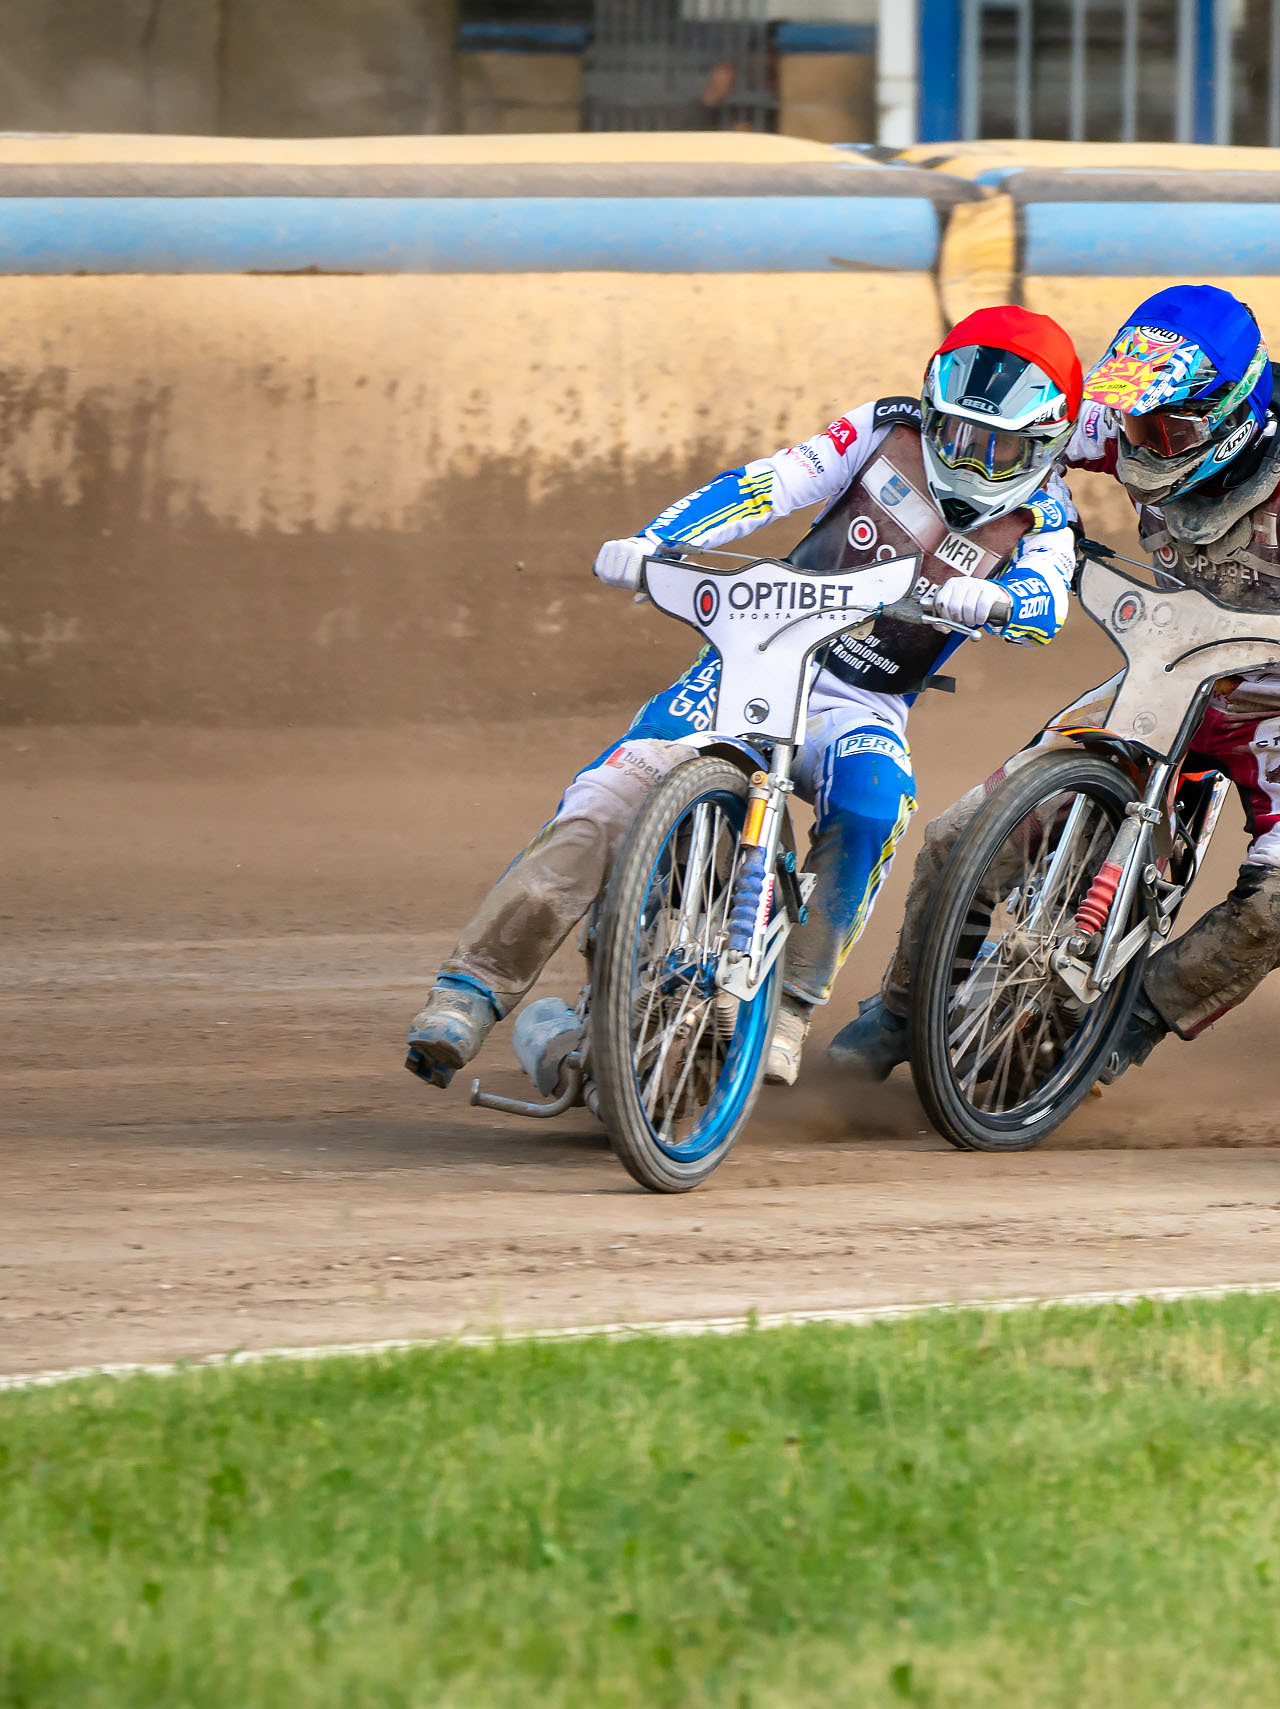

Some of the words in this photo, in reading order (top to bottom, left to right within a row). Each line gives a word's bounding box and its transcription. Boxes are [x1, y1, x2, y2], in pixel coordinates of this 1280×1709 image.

[961, 398, 996, 414] BELL
[938, 535, 978, 571] MFR
[728, 581, 853, 611] OPTIBET
[729, 612, 791, 620] SPORTA
[832, 643, 865, 670] Round
